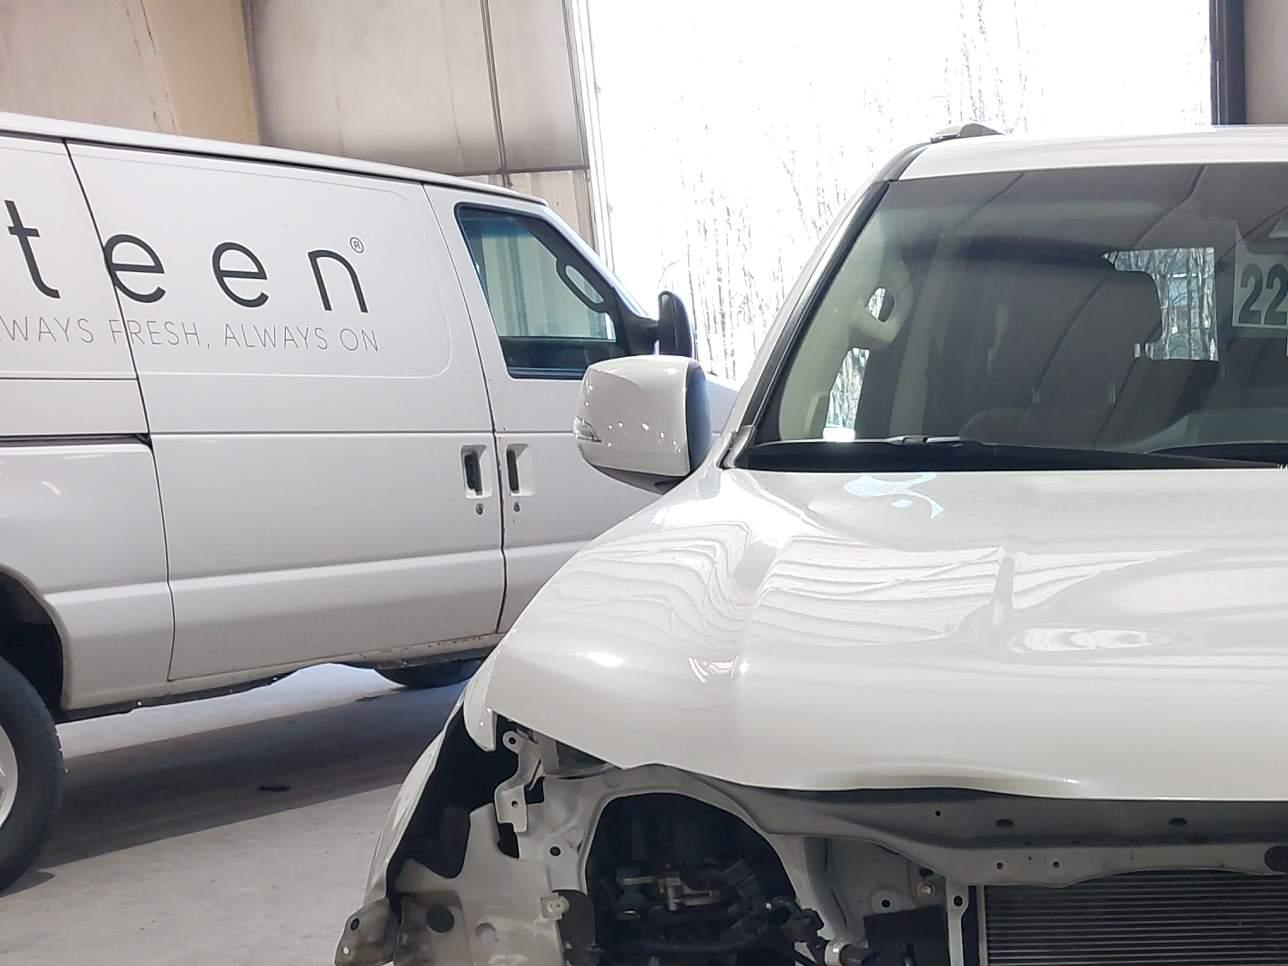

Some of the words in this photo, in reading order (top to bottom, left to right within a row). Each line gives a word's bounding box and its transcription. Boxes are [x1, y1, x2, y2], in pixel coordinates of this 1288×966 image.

[0, 315, 94, 345] WAYS
[108, 318, 210, 350] FRESH,
[224, 322, 329, 351] ALWAYS
[339, 327, 379, 353] ON
